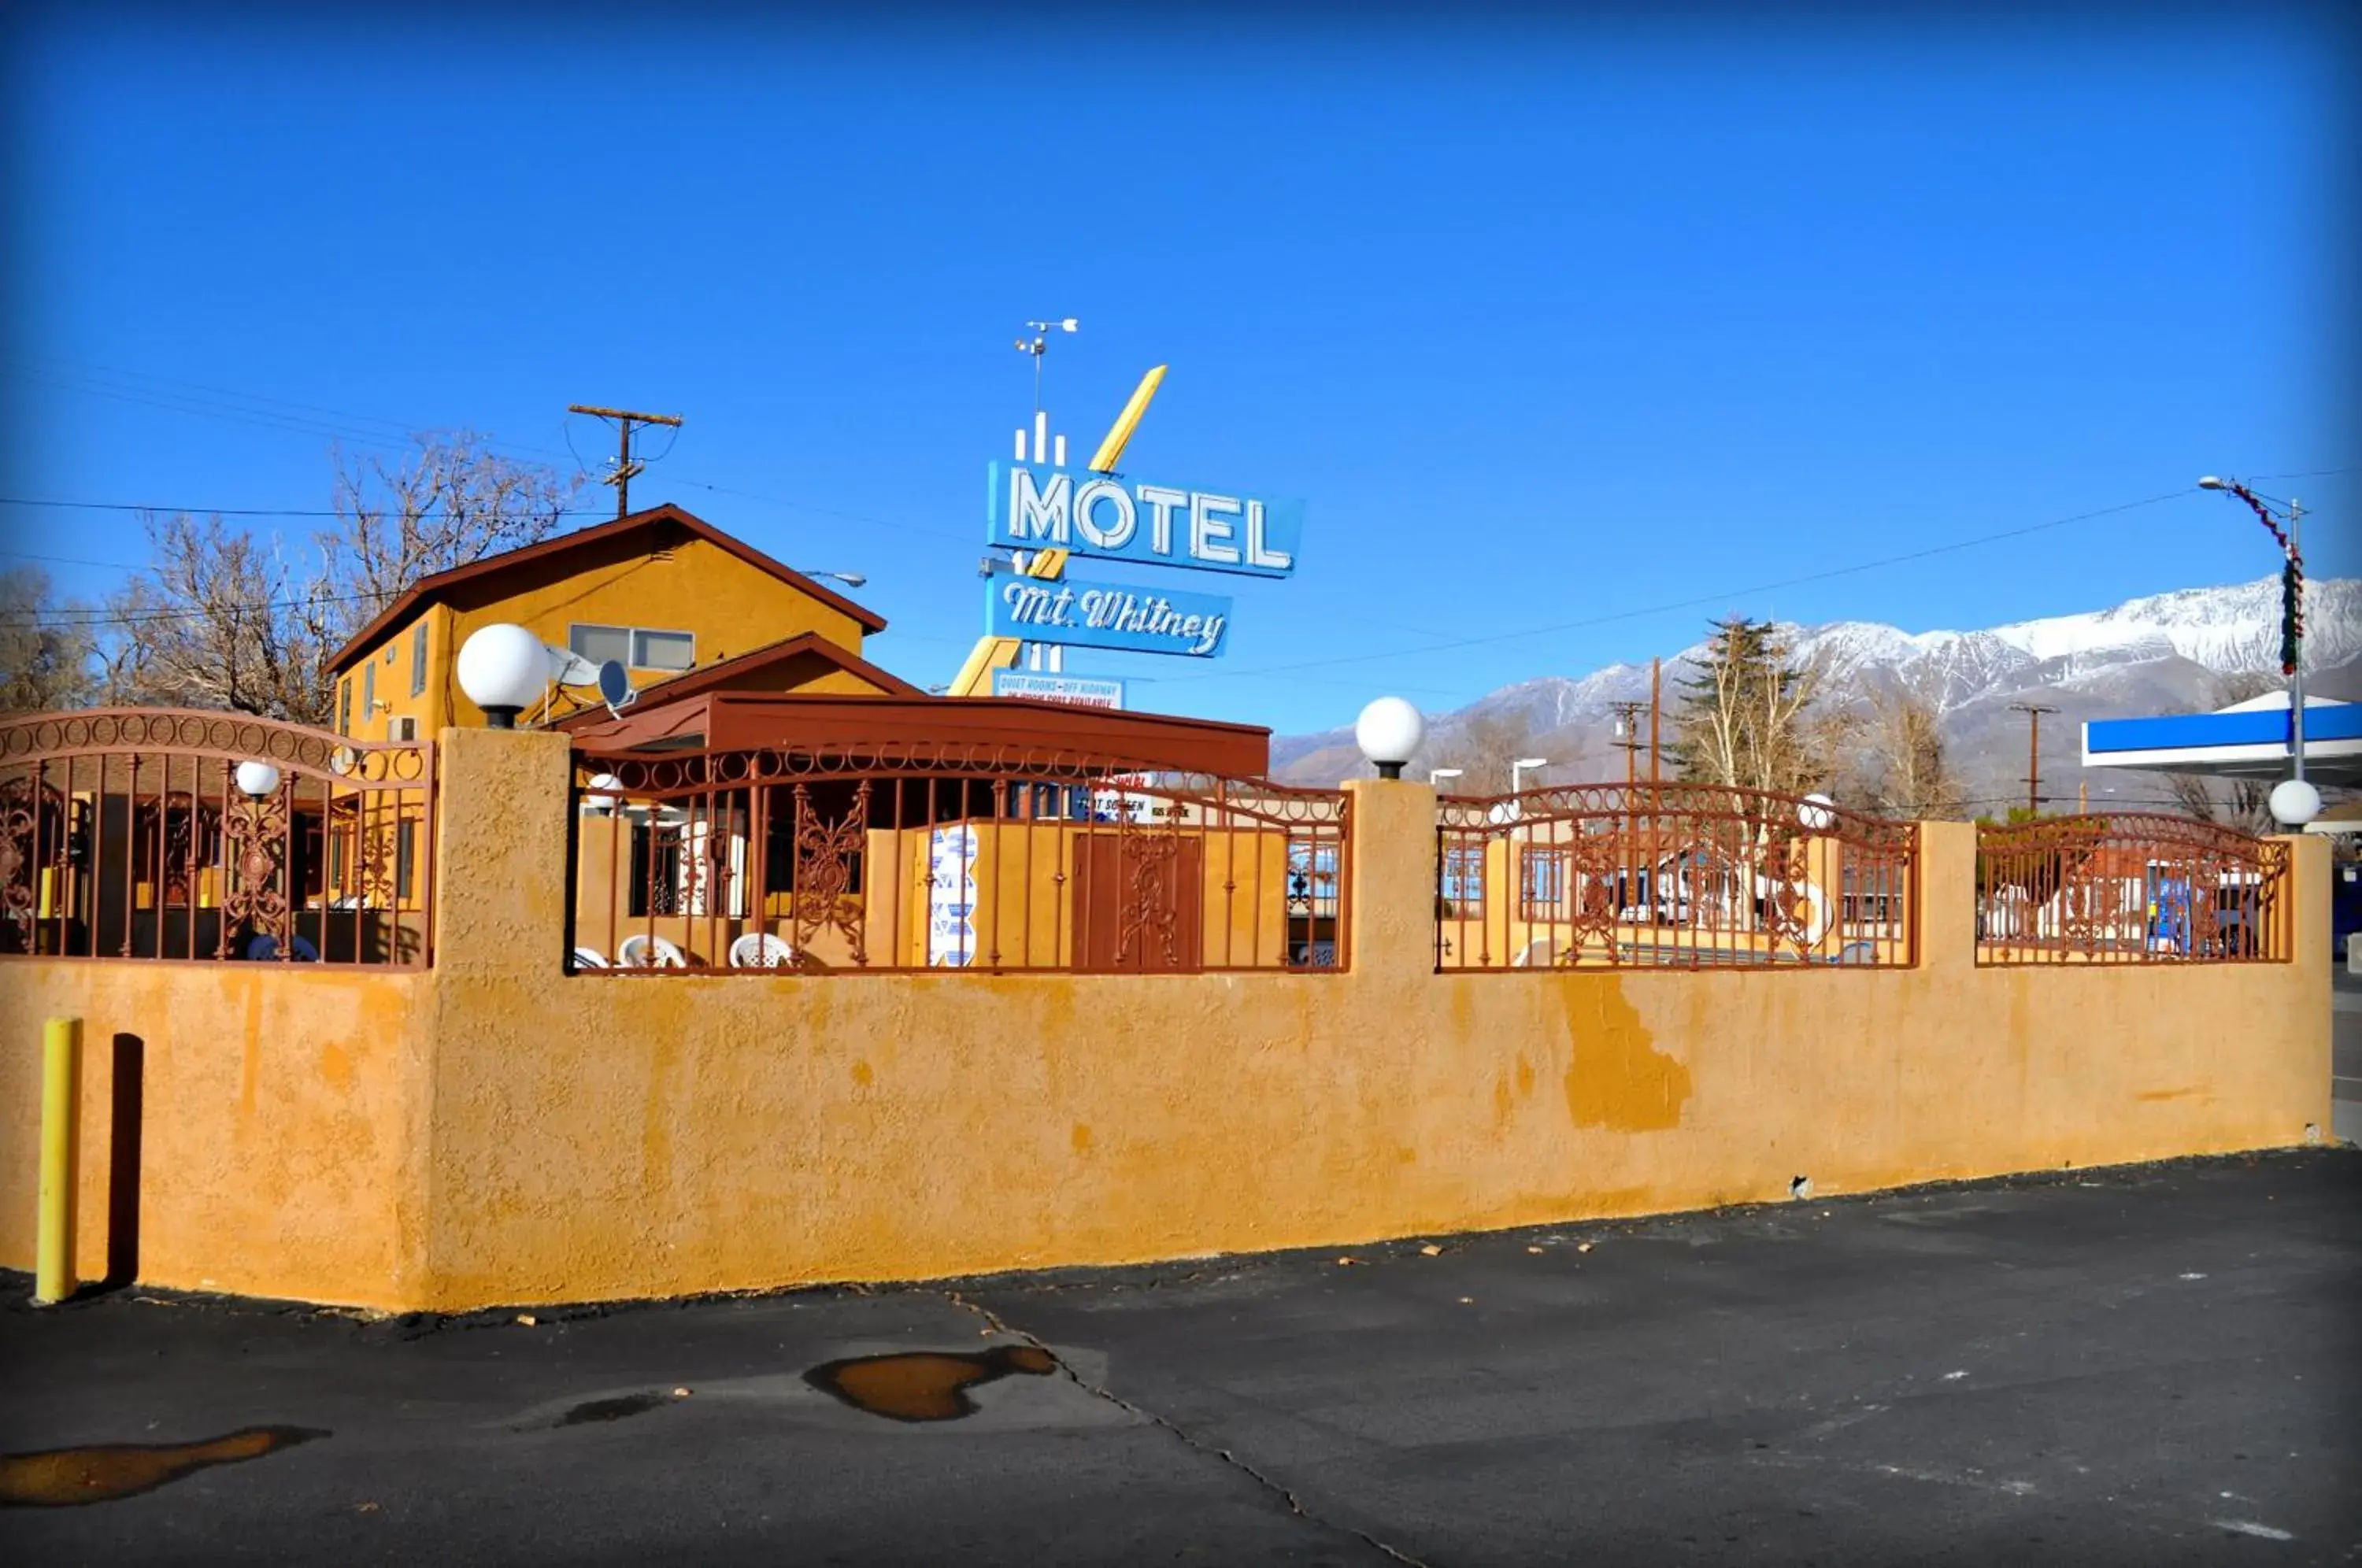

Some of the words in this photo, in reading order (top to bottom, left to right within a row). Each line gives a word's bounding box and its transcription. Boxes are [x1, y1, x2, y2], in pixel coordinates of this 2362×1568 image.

[1009, 466, 1293, 569] MOTEL
[1003, 582, 1078, 627] Mt.
[1080, 590, 1227, 656] Whitney
